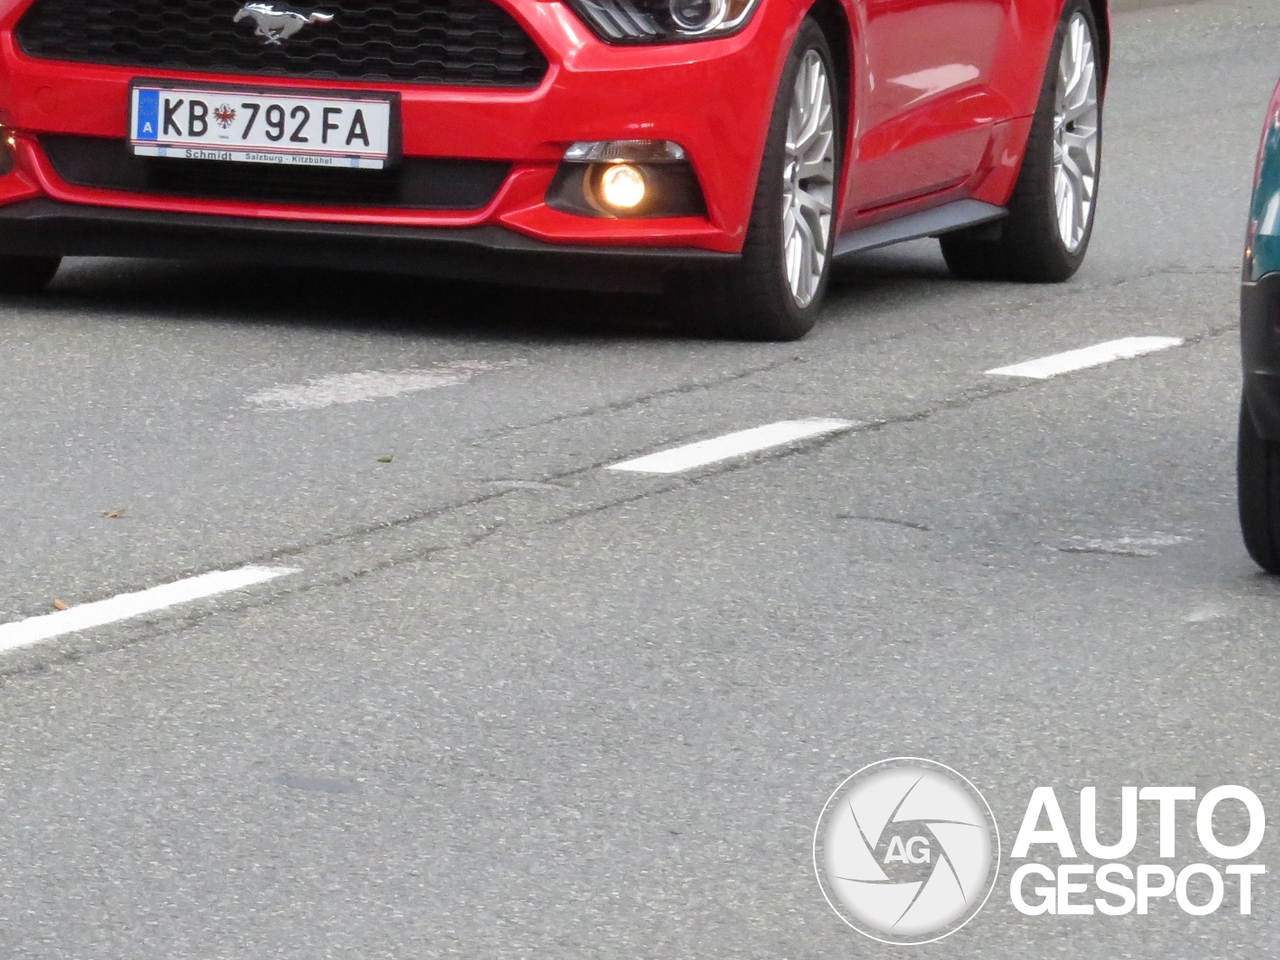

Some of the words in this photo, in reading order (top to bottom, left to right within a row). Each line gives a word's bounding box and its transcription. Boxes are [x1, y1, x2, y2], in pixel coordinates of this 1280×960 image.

[142, 121, 153, 133] A
[162, 98, 209, 138] KB
[185, 149, 233, 161] Schmidt
[245, 152, 283, 164] Salzburg
